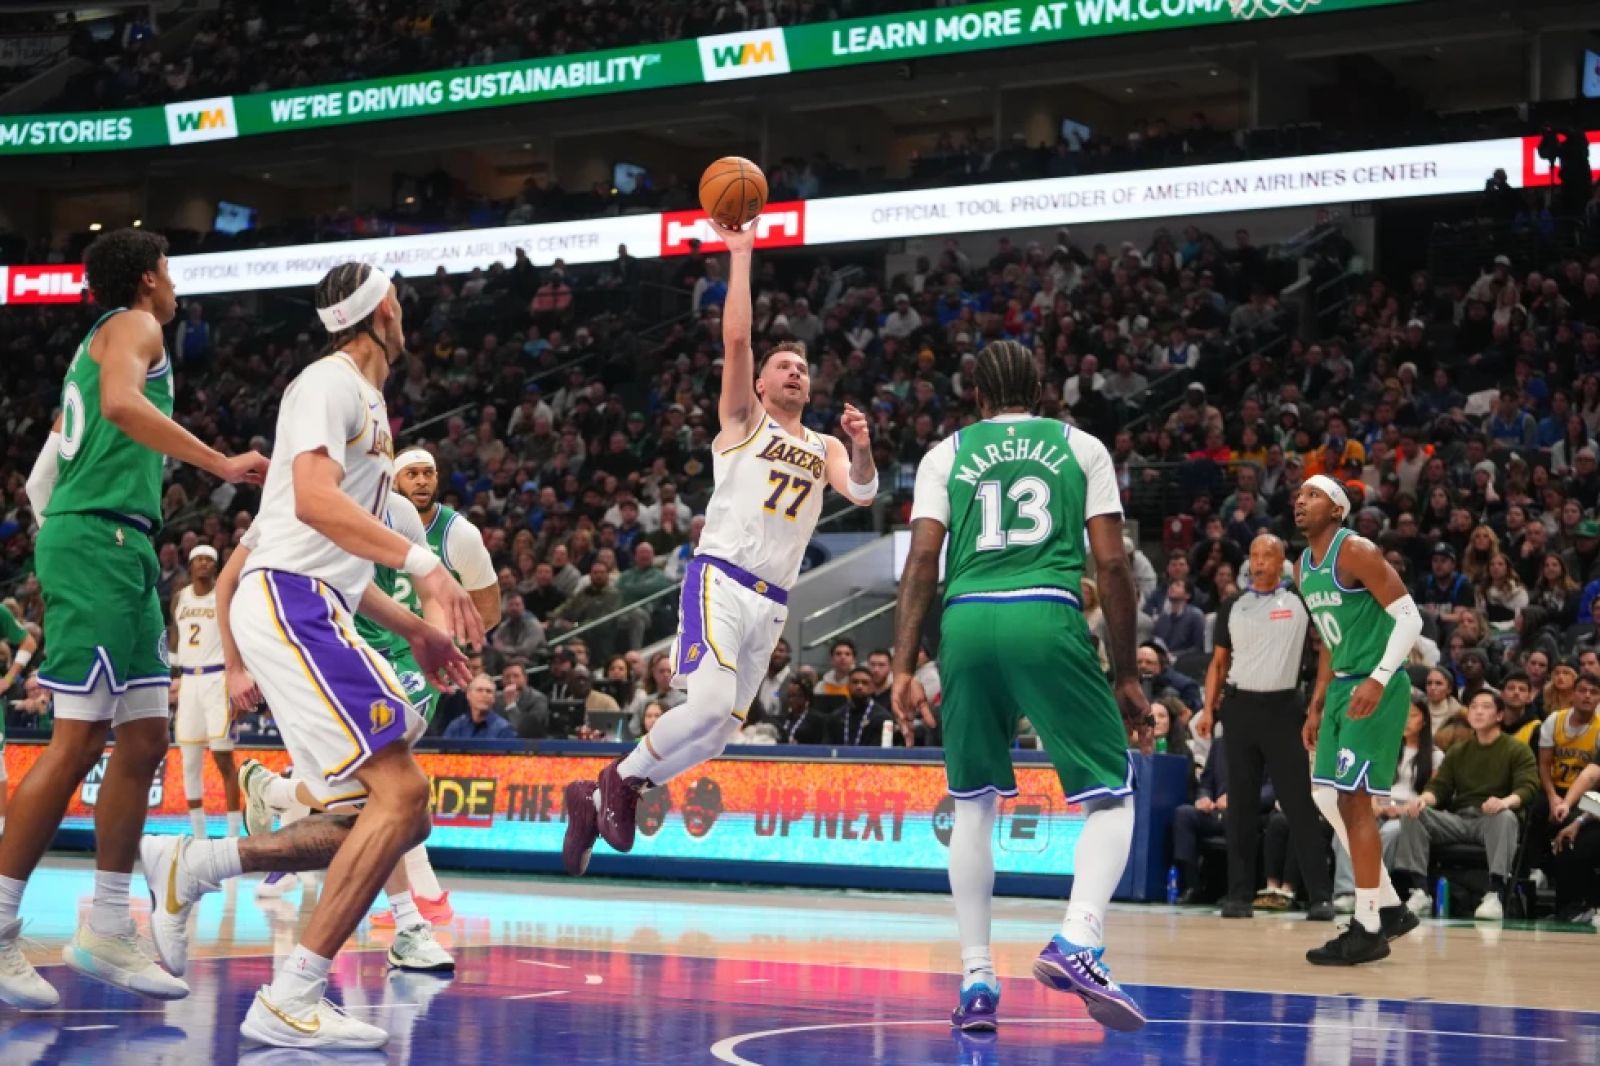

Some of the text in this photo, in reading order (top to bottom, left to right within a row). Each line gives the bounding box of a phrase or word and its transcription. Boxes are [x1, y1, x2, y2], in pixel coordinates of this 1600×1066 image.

[832, 20, 927, 56] LEARN
[935, 8, 1022, 43] MORE
[1029, 3, 1068, 32] AT
[713, 40, 776, 69] WM
[177, 107, 226, 132] WM
[347, 79, 445, 114] DRIVING
[871, 161, 1438, 223] OFFICIAL TOOL PROVIDER OF AMERICAN AIRLINES CENTER
[182, 262, 240, 281] OFFICIAL
[246, 260, 280, 275] TOOL
[384, 245, 460, 264] AMERICAN
[537, 232, 600, 251] CENTER
[756, 435, 825, 479] LAKERS
[954, 438, 1069, 486] MARSHALL
[761, 469, 813, 522] 77
[974, 476, 1053, 552] 13
[189, 623, 201, 647] 2
[507, 784, 554, 822] THE
[754, 786, 911, 842] UP NEXT
